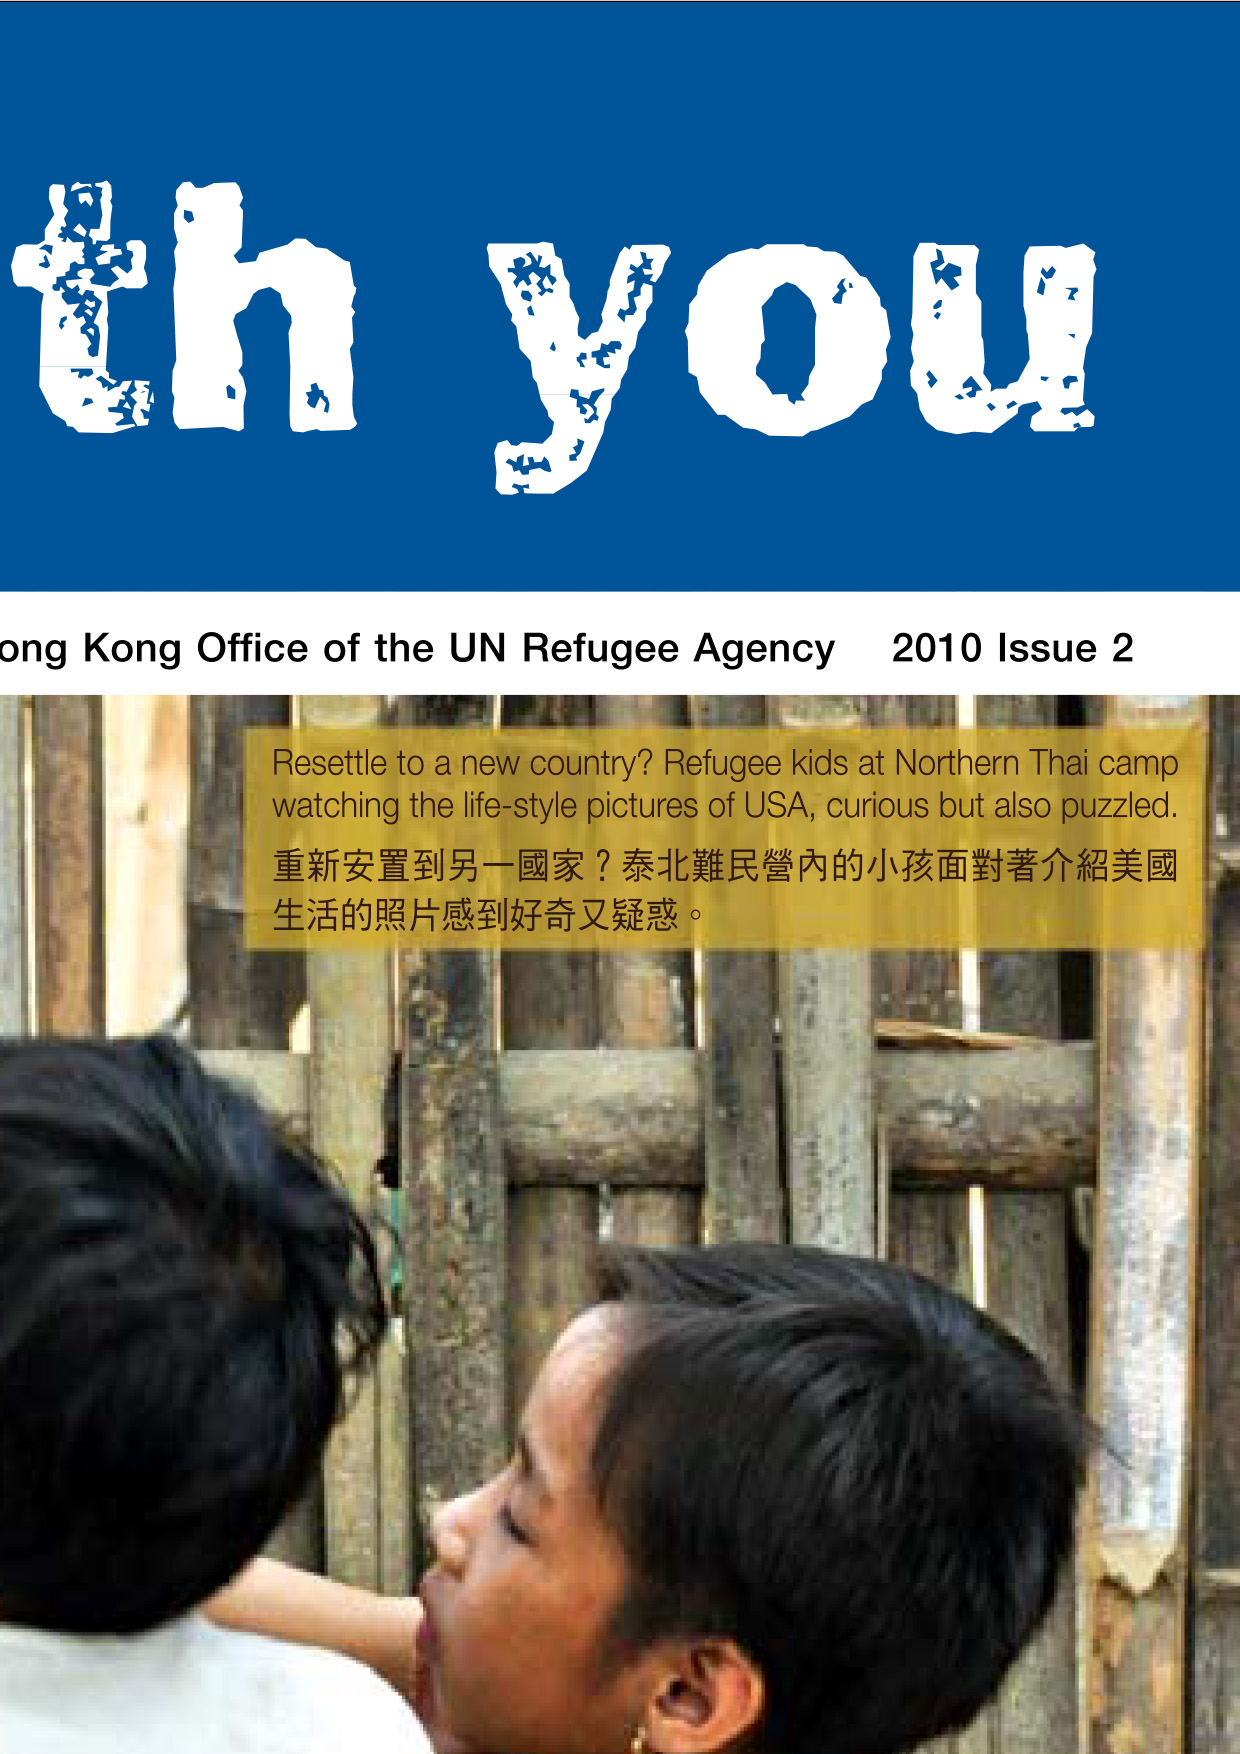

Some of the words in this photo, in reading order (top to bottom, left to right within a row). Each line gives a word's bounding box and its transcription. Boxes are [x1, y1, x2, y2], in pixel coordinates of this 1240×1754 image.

[487, 242, 1096, 495] you
[85, 633, 180, 669] Kong
[198, 632, 307, 662] Office
[324, 633, 360, 662] of
[375, 633, 433, 662] the
[451, 633, 504, 662] UN
[525, 633, 678, 669] Refugee
[694, 633, 835, 669] Agency
[893, 633, 981, 662] 2010
[1000, 633, 1096, 662] Issue
[1113, 633, 1132, 661] 2
